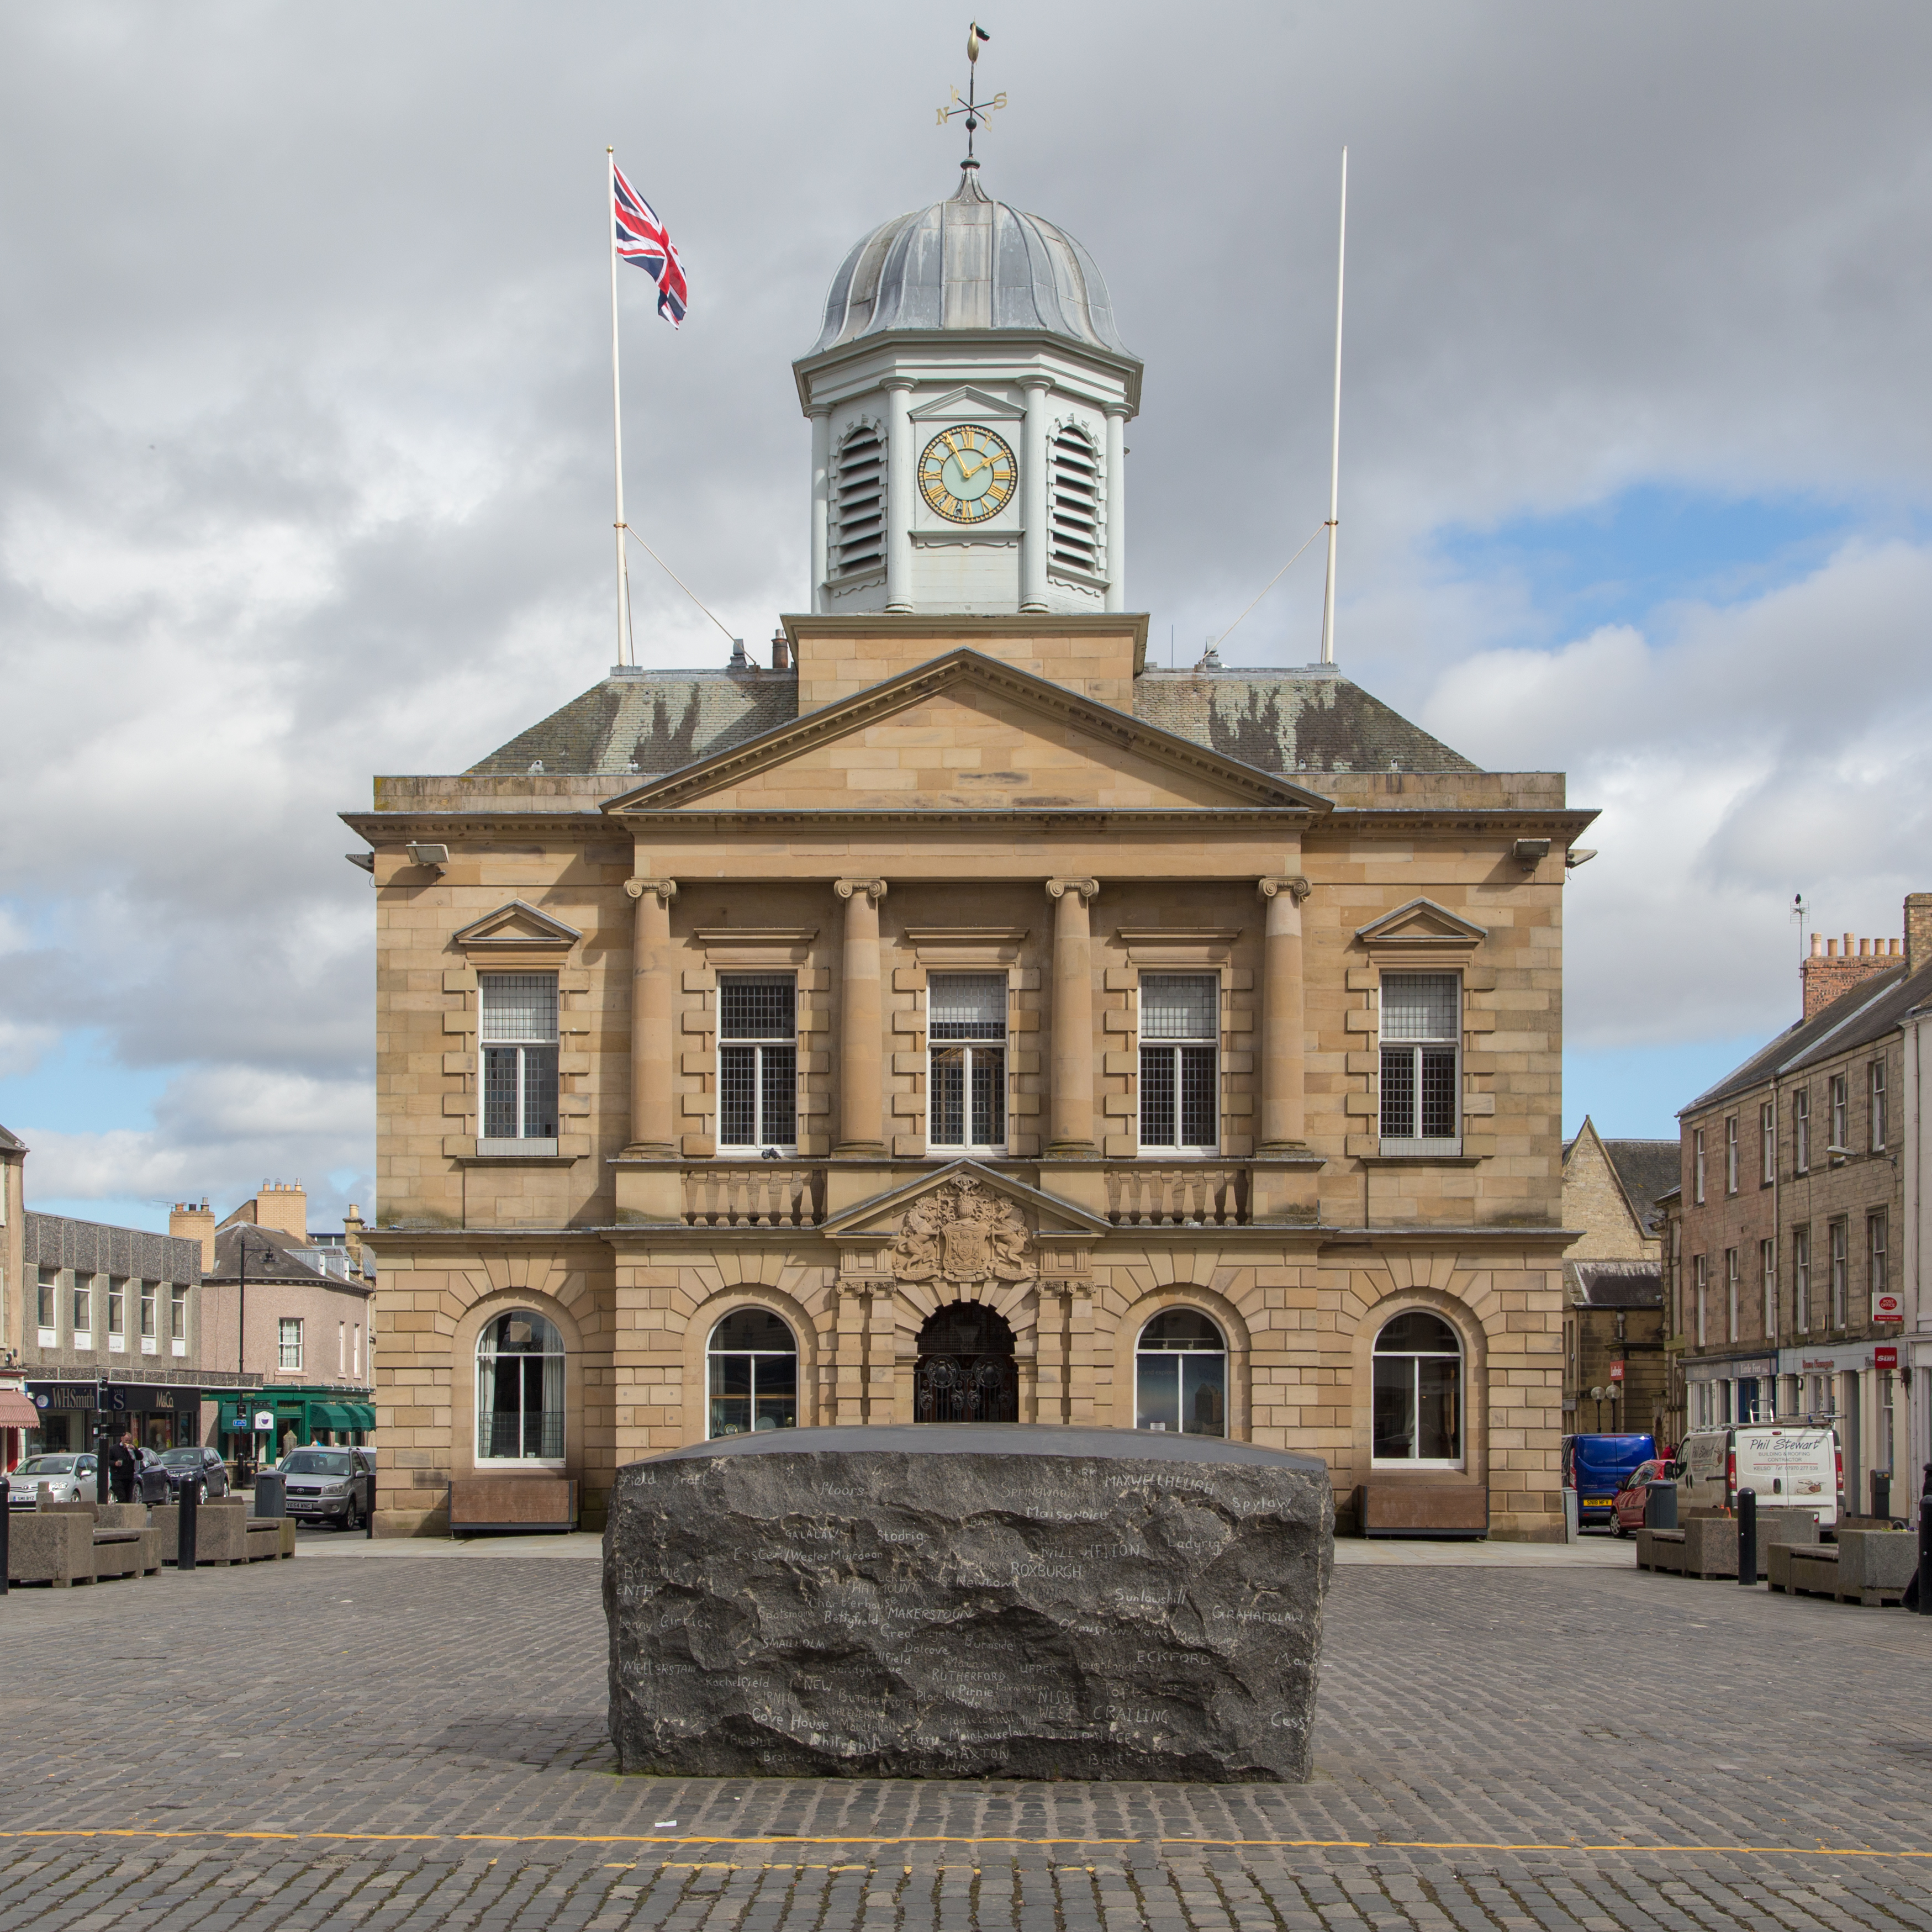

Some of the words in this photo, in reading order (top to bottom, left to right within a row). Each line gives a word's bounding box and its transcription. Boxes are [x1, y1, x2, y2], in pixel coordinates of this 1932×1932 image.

[950, 84, 959, 105] W
[994, 92, 1008, 111] S
[936, 106, 949, 126] N
[984, 111, 992, 133] E
[960, 431, 975, 449] XII
[994, 470, 1011, 480] III
[1741, 1364, 1751, 1374] Little
[1752, 1363, 1761, 1373] Feet
[52, 1387, 95, 1408] WHSmith
[113, 1393, 125, 1410] S
[1750, 1439, 1770, 1450] Phil
[1773, 1439, 1820, 1450] Stewart
[1105, 1474, 1215, 1495] MAXWELLHEUGH
[785, 1529, 839, 1540] GALALAW
[877, 1529, 925, 1546] Stodrig
[1011, 1562, 1082, 1580] ROXBURGH
[808, 1596, 898, 1610] Charterhouse
[1114, 1587, 1186, 1604] Sunlawshill
[887, 1606, 974, 1622] MAKERSTOUN
[1212, 1605, 1303, 1623] GRAHAMSLAW
[903, 1641, 951, 1655] Dalcove
[964, 1635, 1013, 1651] Burnside
[1136, 1650, 1211, 1665] ECKFORD
[932, 1667, 1006, 1682] RUTHERFORD
[804, 1678, 833, 1692] NEW
[959, 1685, 994, 1697] Pirnie
[752, 1707, 784, 1725] Cove
[790, 1714, 829, 1731] House
[1039, 1705, 1075, 1721] WEST
[1093, 1704, 1169, 1724] CRAILING
[944, 1747, 1010, 1761] MAXTON
